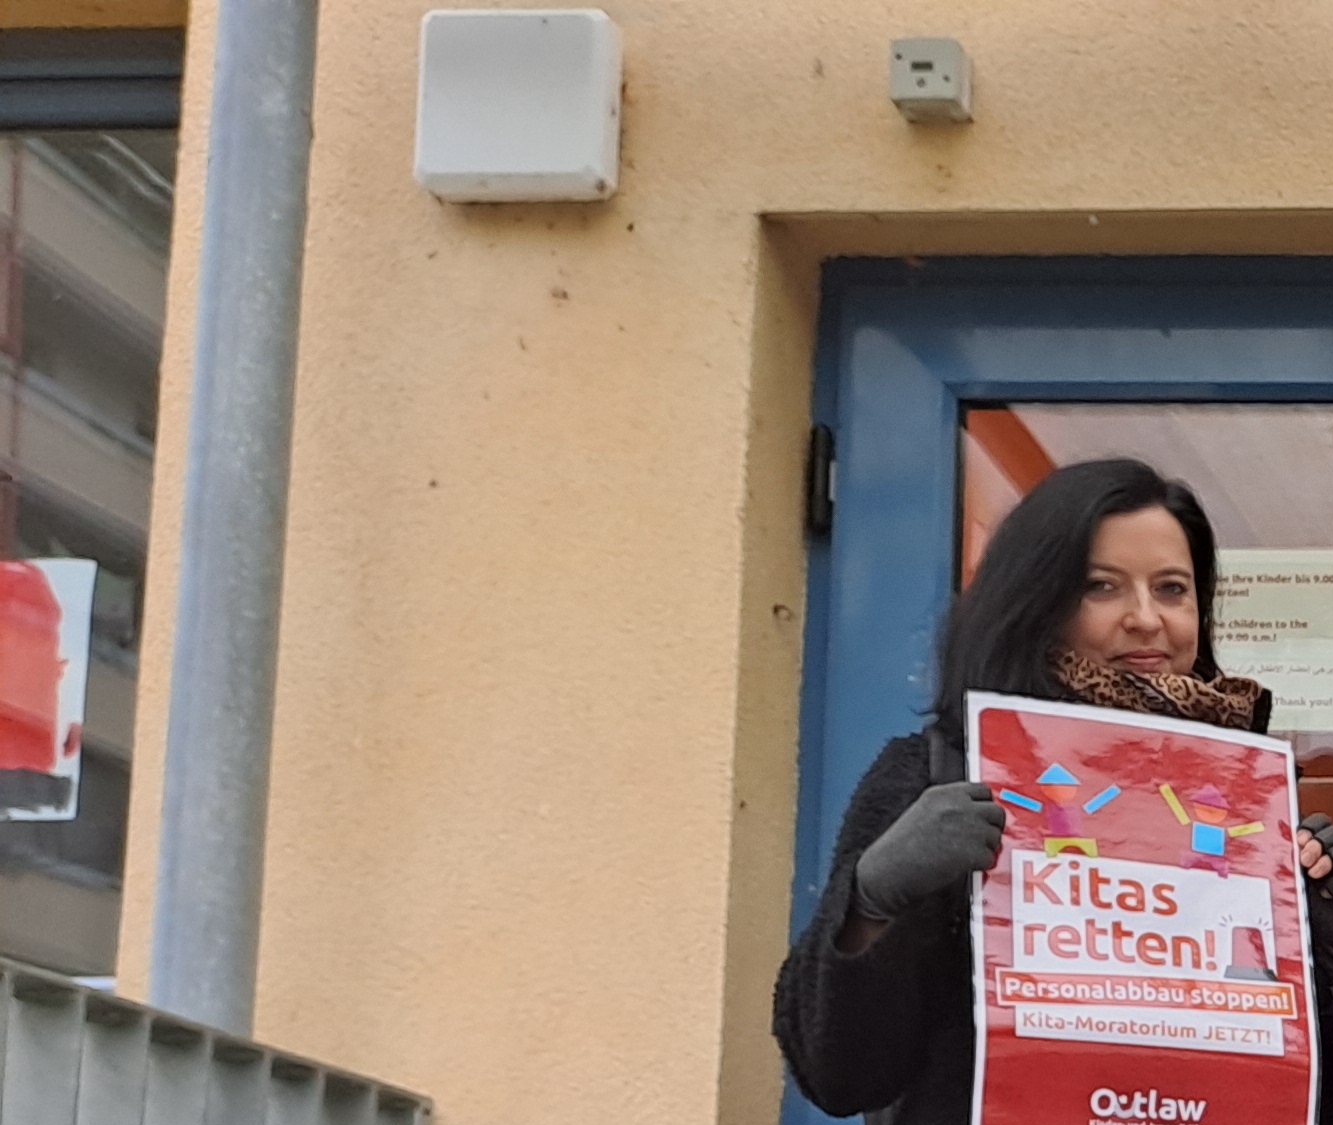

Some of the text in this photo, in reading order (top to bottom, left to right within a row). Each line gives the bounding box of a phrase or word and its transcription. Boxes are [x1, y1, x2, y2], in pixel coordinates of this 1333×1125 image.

[1232, 574, 1253, 583] Ihre
[1257, 574, 1292, 583] Kinder
[1295, 574, 1311, 583] bis
[1228, 619, 1272, 628] children
[1275, 620, 1287, 628] to
[1290, 619, 1308, 628] the
[1275, 697, 1306, 706] Thank
[1022, 859, 1178, 916] Kitas
[1023, 918, 1217, 971] retten!
[1005, 976, 1289, 1011] Personalabbau stoppen!
[1022, 1011, 1272, 1044] Kita-Moratorium JETZT!
[1090, 1087, 1207, 1122] Outlaw
